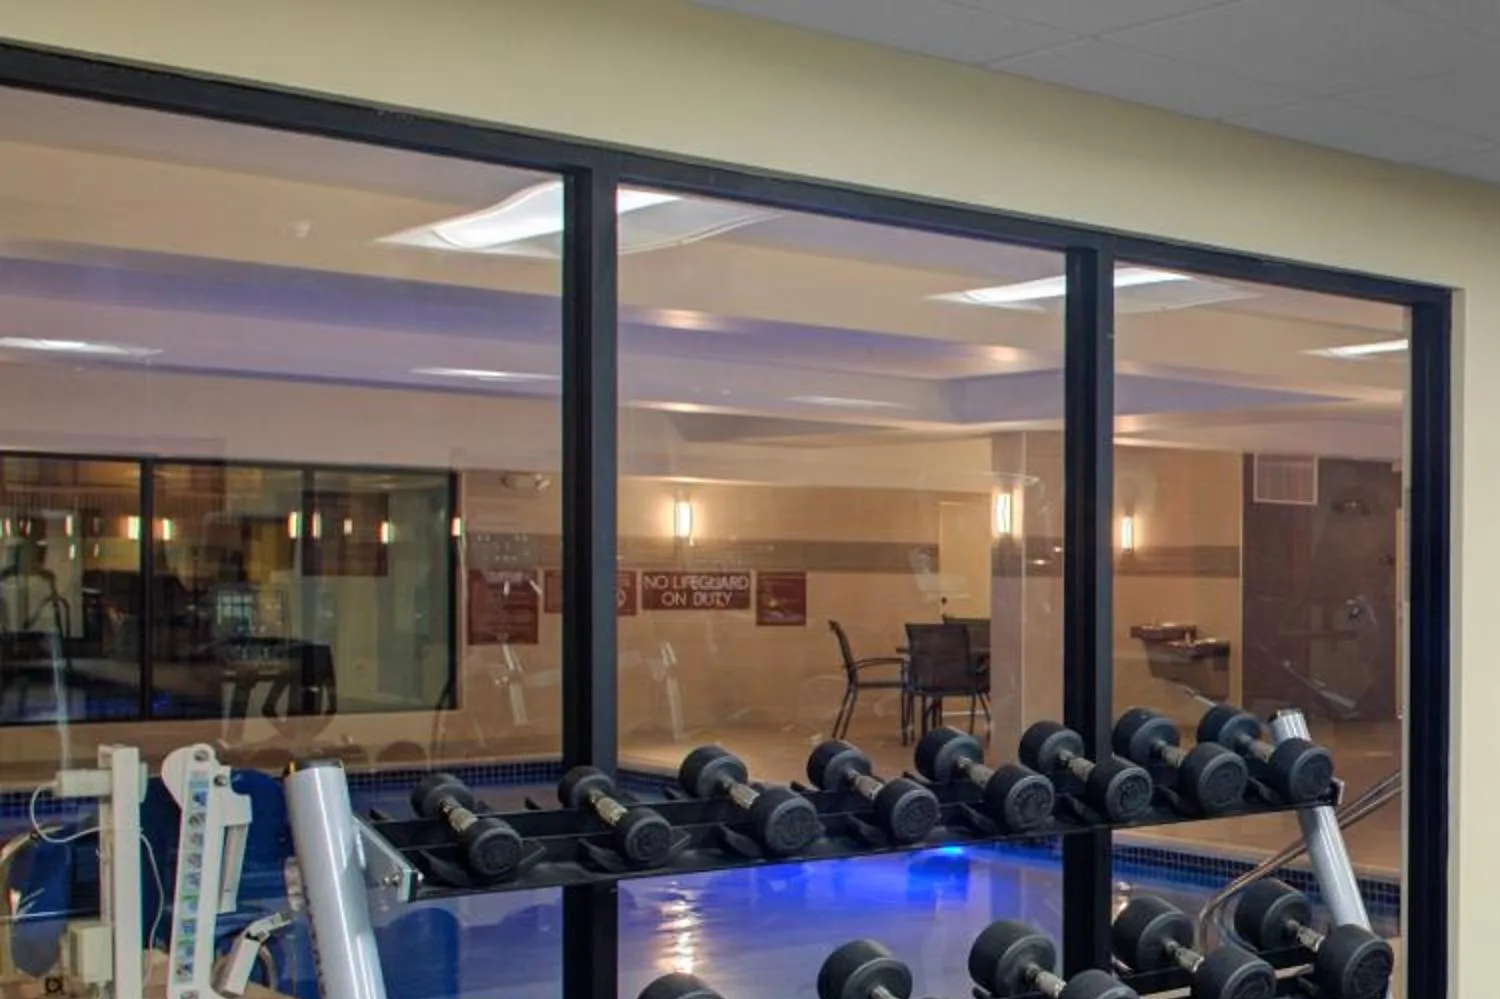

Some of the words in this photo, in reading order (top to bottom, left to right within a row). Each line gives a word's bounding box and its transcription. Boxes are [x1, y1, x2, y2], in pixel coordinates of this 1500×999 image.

[642, 575, 669, 590] NO
[672, 575, 749, 591] LIFEGUARD
[660, 591, 688, 607] ON
[692, 591, 733, 607] DUTY
